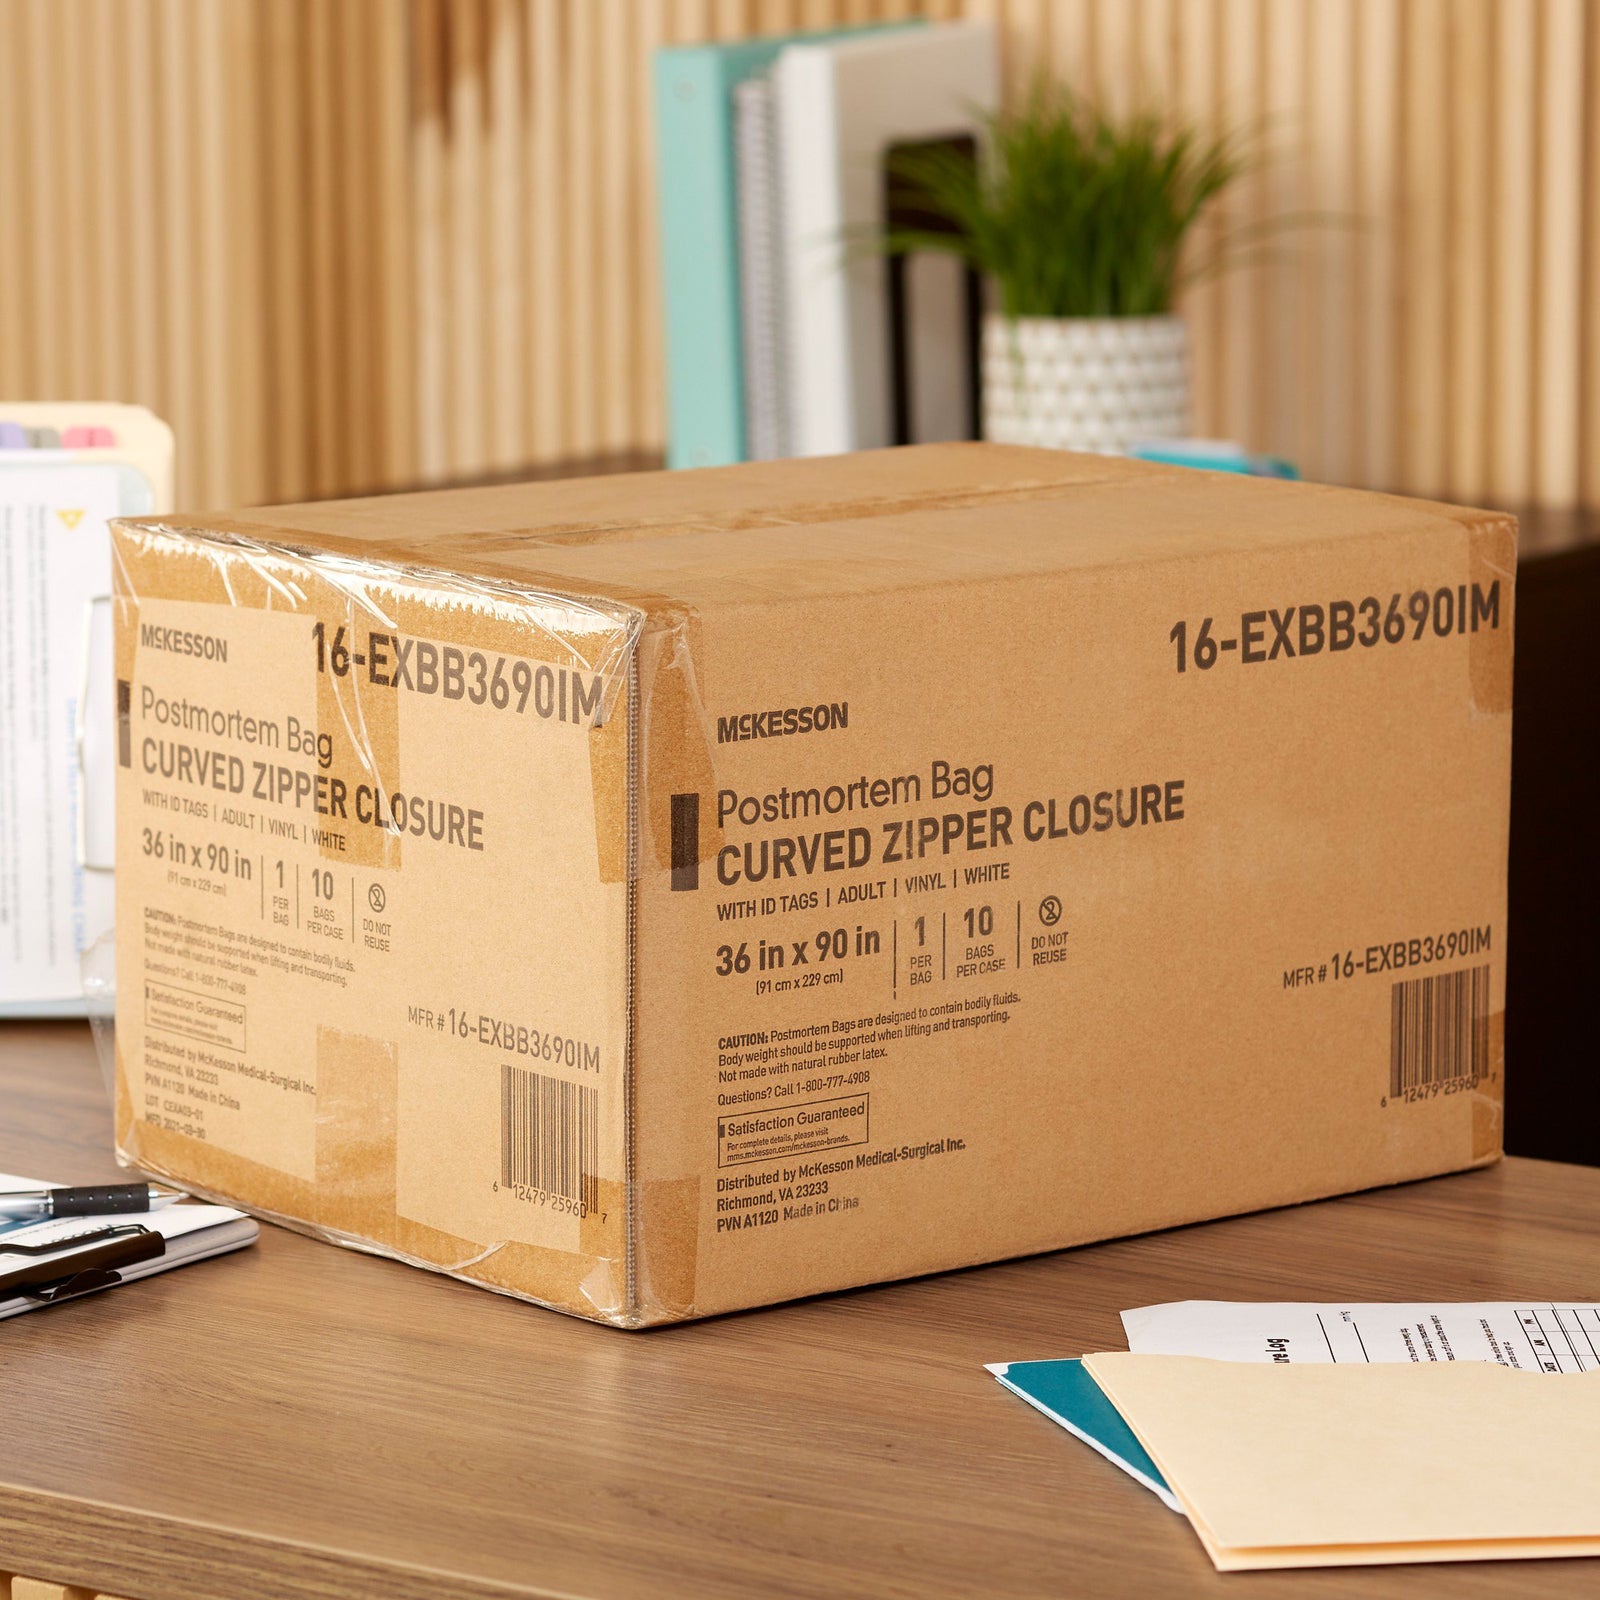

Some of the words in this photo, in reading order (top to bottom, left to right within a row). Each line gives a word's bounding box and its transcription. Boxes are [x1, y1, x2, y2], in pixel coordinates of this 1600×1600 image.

[1169, 579, 1500, 673] 16-EXBB3690IM
[312, 621, 603, 725] 16-EXBB3690IM
[141, 685, 279, 749] Postmortem
[287, 716, 333, 770] Bag
[142, 737, 244, 794] CURVED
[252, 761, 348, 819] ZIPPER
[355, 785, 484, 852] CLOSURE
[718, 774, 921, 829] Postmortem
[931, 760, 994, 802] Bag
[141, 788, 168, 809] WITH
[169, 795, 180, 812] ID
[182, 798, 209, 819] TAGS
[222, 808, 255, 829] ADULT
[268, 818, 299, 841] VINYL
[312, 828, 346, 852] WHITE
[717, 827, 871, 886] CURVED
[882, 806, 1013, 863] ZIPPER
[1023, 779, 1185, 842] CLOSURE
[142, 828, 164, 858] 36
[169, 833, 186, 864] in
[191, 844, 203, 869] x
[206, 843, 229, 874] 90
[234, 849, 252, 881] in
[276, 860, 284, 889] 1
[311, 868, 334, 901] 10
[273, 895, 289, 911] PER
[717, 900, 757, 921] WITH
[761, 897, 776, 916] ID
[779, 891, 819, 913] TAGS
[837, 881, 887, 905] ADULT
[905, 872, 947, 894] VINYL
[964, 862, 1010, 885] WHITE
[273, 911, 289, 927] BAG
[307, 919, 323, 937] PER
[323, 923, 344, 941] CASE
[314, 906, 335, 922] BAGS
[363, 918, 374, 933] DO
[375, 921, 392, 937] NOT
[963, 905, 994, 938] 10
[364, 936, 390, 953] REUSE
[914, 916, 925, 946] 1
[1031, 935, 1046, 950] DO
[1047, 931, 1069, 947] NOT
[249, 933, 279, 954] designed
[280, 942, 287, 953] to
[287, 946, 312, 961] contain
[313, 948, 334, 969] bodily
[334, 956, 356, 972] fluids.
[715, 942, 751, 977] 36
[759, 939, 785, 971] in
[791, 941, 809, 966] x
[815, 928, 848, 962] 90
[856, 925, 880, 957] in
[910, 954, 932, 970] PER
[965, 944, 994, 961] BAGS
[1033, 948, 1068, 966] REUSE
[1283, 966, 1315, 989] MFR
[1317, 963, 1328, 983] #
[1331, 924, 1491, 980] 16-EXBB3690IM
[251, 953, 270, 965] when
[270, 956, 290, 973] lifting
[290, 962, 304, 974] and
[304, 965, 348, 988] transporting.
[755, 980, 772, 996] (91
[774, 979, 792, 992] cm
[793, 978, 801, 990] x
[802, 972, 821, 988] 229
[823, 968, 844, 985] cm)
[909, 970, 932, 986] BAG
[956, 963, 977, 978] PER
[979, 958, 1006, 974] CASE
[195, 1001, 243, 1025] Guaranteed
[718, 1031, 769, 1050] CAUTION:
[770, 1024, 830, 1043] Postmortem
[831, 1019, 857, 1034] Bags
[857, 1017, 874, 1029] are
[875, 1009, 917, 1027] designed
[918, 1007, 928, 1019] to
[929, 1000, 963, 1017] contain
[964, 996, 992, 1011] bodily
[992, 991, 1022, 1007] fluids.
[408, 1005, 434, 1030] MFR
[436, 1013, 446, 1032] #
[448, 1007, 600, 1074] 16-EXBB3690IM
[718, 1053, 744, 1068] Body
[745, 1047, 779, 1065] weight
[780, 1041, 813, 1058] should
[814, 1040, 827, 1053] be
[828, 1030, 877, 1051] supported
[877, 1028, 904, 1042] when
[904, 1022, 931, 1038] lifting
[932, 1017, 951, 1033] and
[951, 1009, 1012, 1030] transporting.
[238, 1061, 301, 1093] Medical-Surgical
[302, 1080, 317, 1096] Inc.
[718, 1070, 737, 1084] Not
[739, 1066, 767, 1080] made
[768, 1061, 790, 1076] with
[791, 1055, 827, 1072] natural
[827, 1050, 861, 1067] rubber
[861, 1047, 889, 1062] latex.
[218, 1093, 241, 1111] China
[717, 1086, 773, 1107] Questions?
[774, 1082, 795, 1098] Call
[796, 1070, 870, 1095] 1-800-777-4908
[1380, 1096, 1388, 1108] 6
[1403, 1081, 1439, 1104] 12479
[1443, 1073, 1480, 1096] 25960
[727, 1115, 795, 1137] Satisfaction
[796, 1101, 866, 1126] Guaranteed
[727, 1142, 739, 1152] For
[739, 1137, 769, 1150] complete
[769, 1132, 793, 1145] details,
[793, 1130, 815, 1142] please
[815, 1127, 829, 1137] visit
[716, 1169, 780, 1193] Distributed
[783, 1168, 797, 1184] by
[798, 1158, 854, 1179] McKesson
[856, 1138, 945, 1168] Medical-Surgical
[945, 1137, 967, 1153] Inc.
[492, 1180, 499, 1193] 6
[512, 1183, 547, 1207] 12479
[551, 1194, 588, 1220] 25960
[716, 1190, 777, 1213] Richmond,
[778, 1186, 794, 1202] VA
[795, 1180, 829, 1200] 23233
[601, 1212, 608, 1225] 7
[716, 1214, 742, 1233] PVN
[743, 1208, 779, 1229] A1120
[783, 1204, 814, 1221] Made
[815, 1200, 826, 1215] in
[1265, 1338, 1290, 1352] Log
